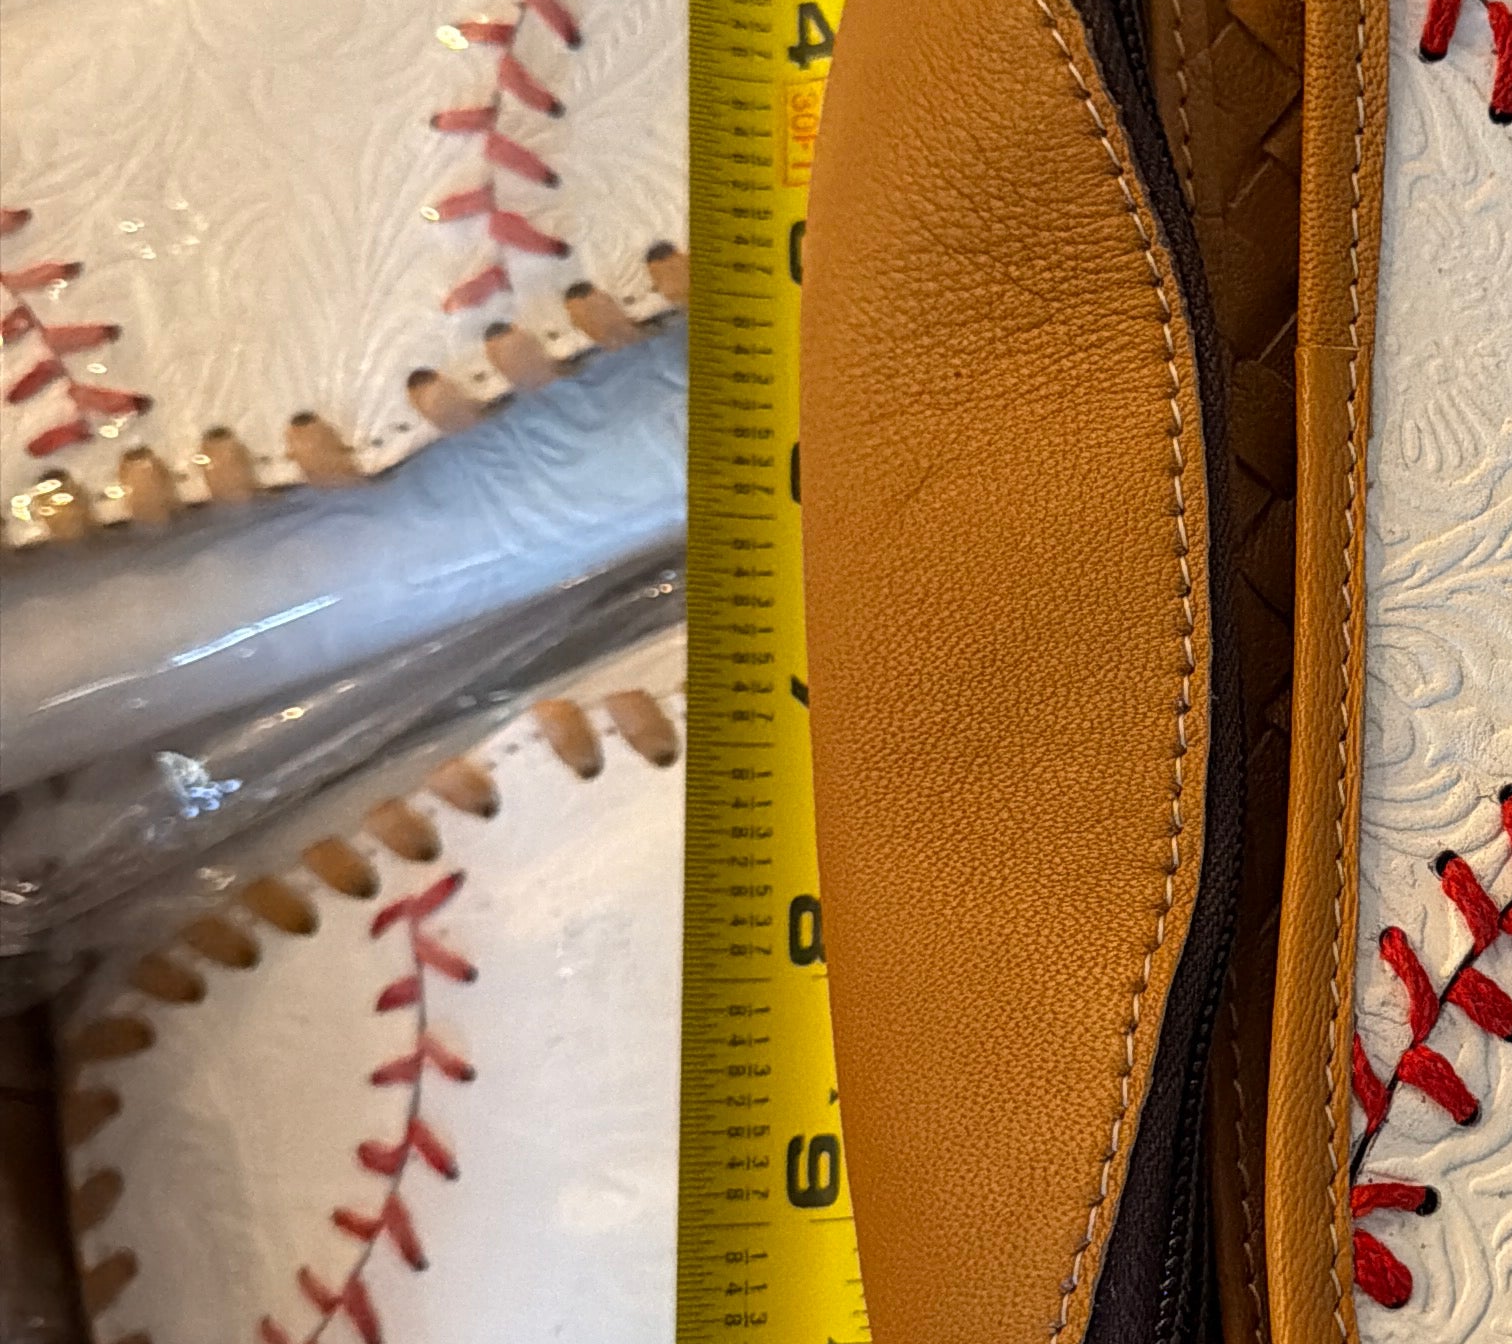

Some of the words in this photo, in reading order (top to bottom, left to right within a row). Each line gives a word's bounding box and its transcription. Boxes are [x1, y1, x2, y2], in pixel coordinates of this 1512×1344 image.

[787, 2, 834, 71] 4
[787, 894, 826, 967] 8
[785, 1133, 840, 1208] 9
